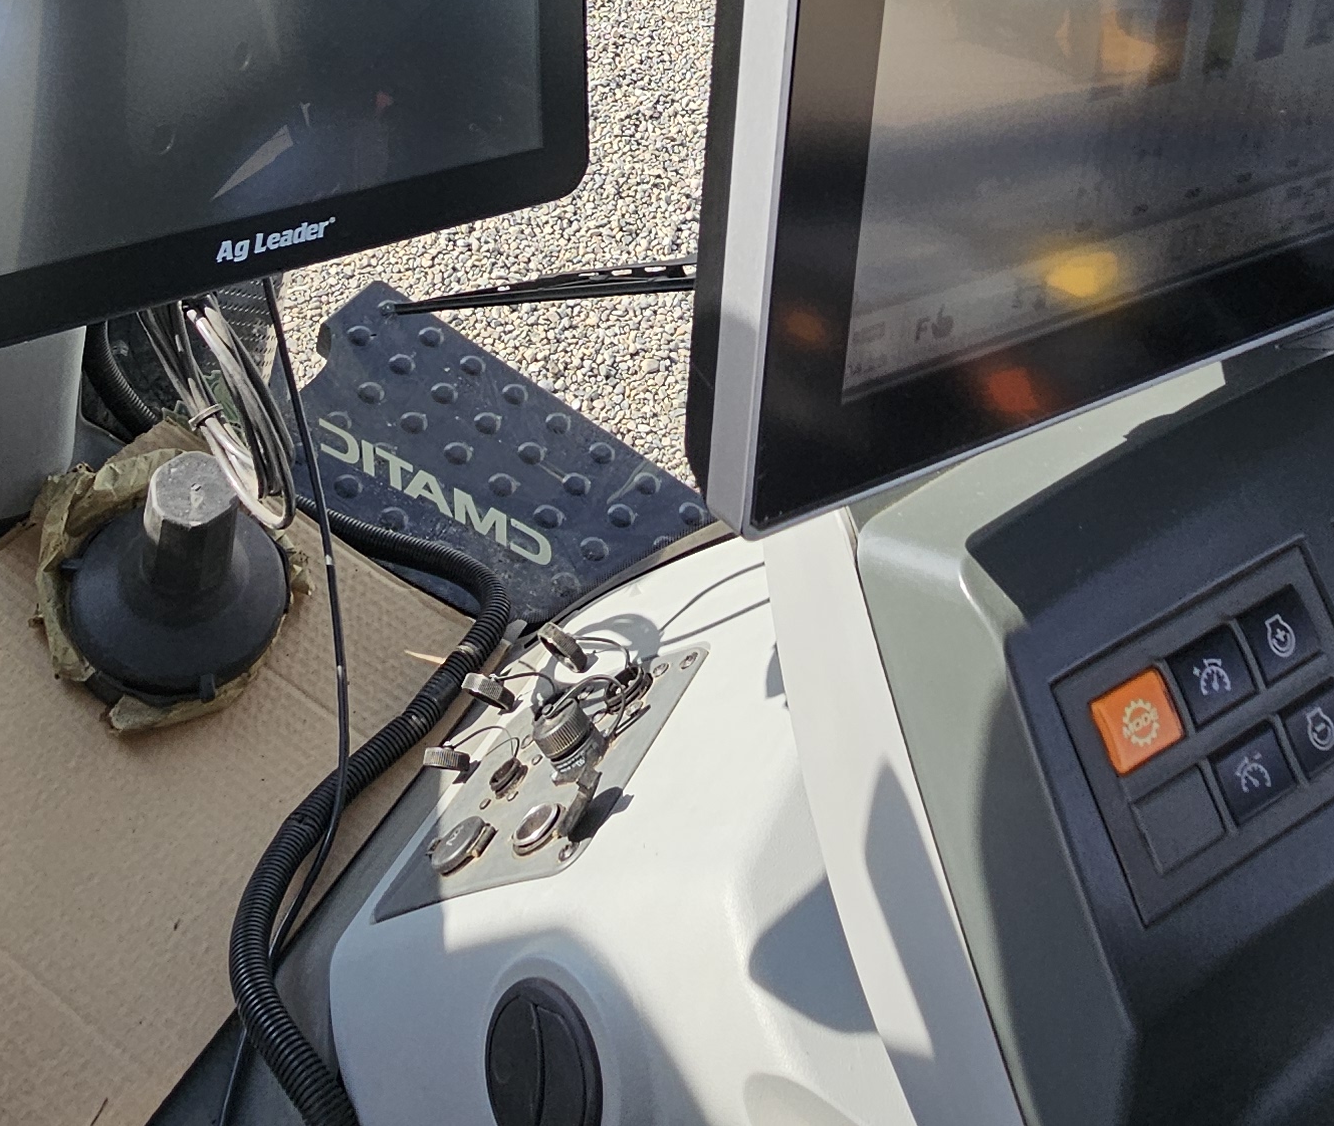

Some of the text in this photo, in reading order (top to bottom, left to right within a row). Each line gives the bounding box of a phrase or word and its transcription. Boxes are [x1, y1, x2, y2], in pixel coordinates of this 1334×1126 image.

[216, 221, 329, 263] Ag Leader
[1122, 707, 1159, 740] MODE
